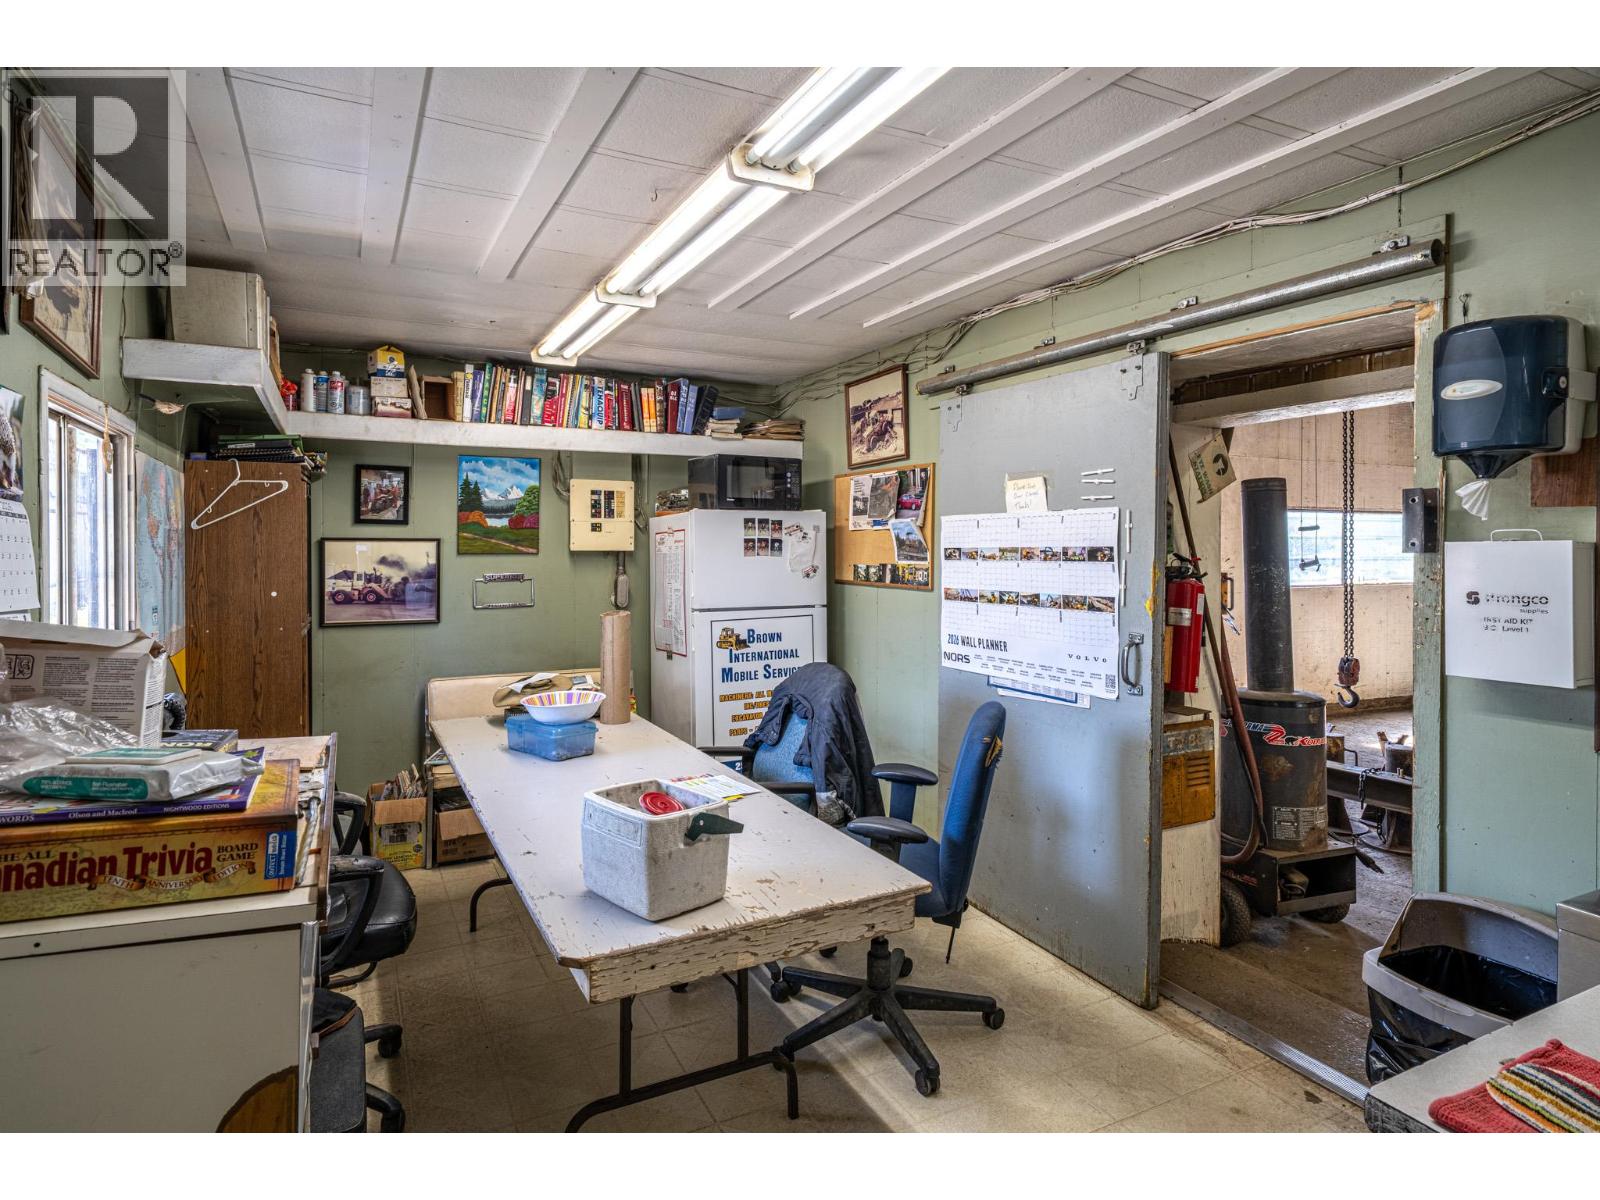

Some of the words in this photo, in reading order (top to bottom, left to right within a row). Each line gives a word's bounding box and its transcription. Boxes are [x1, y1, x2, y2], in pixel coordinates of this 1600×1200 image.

[747, 628, 782, 644] BROWN
[947, 633, 960, 645] 2026
[960, 635, 977, 648] WALL
[977, 637, 1008, 652] PLANNER
[729, 648, 800, 663] INTERNATIONAL
[943, 651, 971, 664] NORS
[1068, 653, 1107, 663] VOLVO
[721, 667, 759, 683] MOBILE
[217, 842, 259, 853] BOARD
[216, 852, 256, 862] GAME
[0, 851, 117, 892] nadian
[123, 842, 213, 881] Trivia
